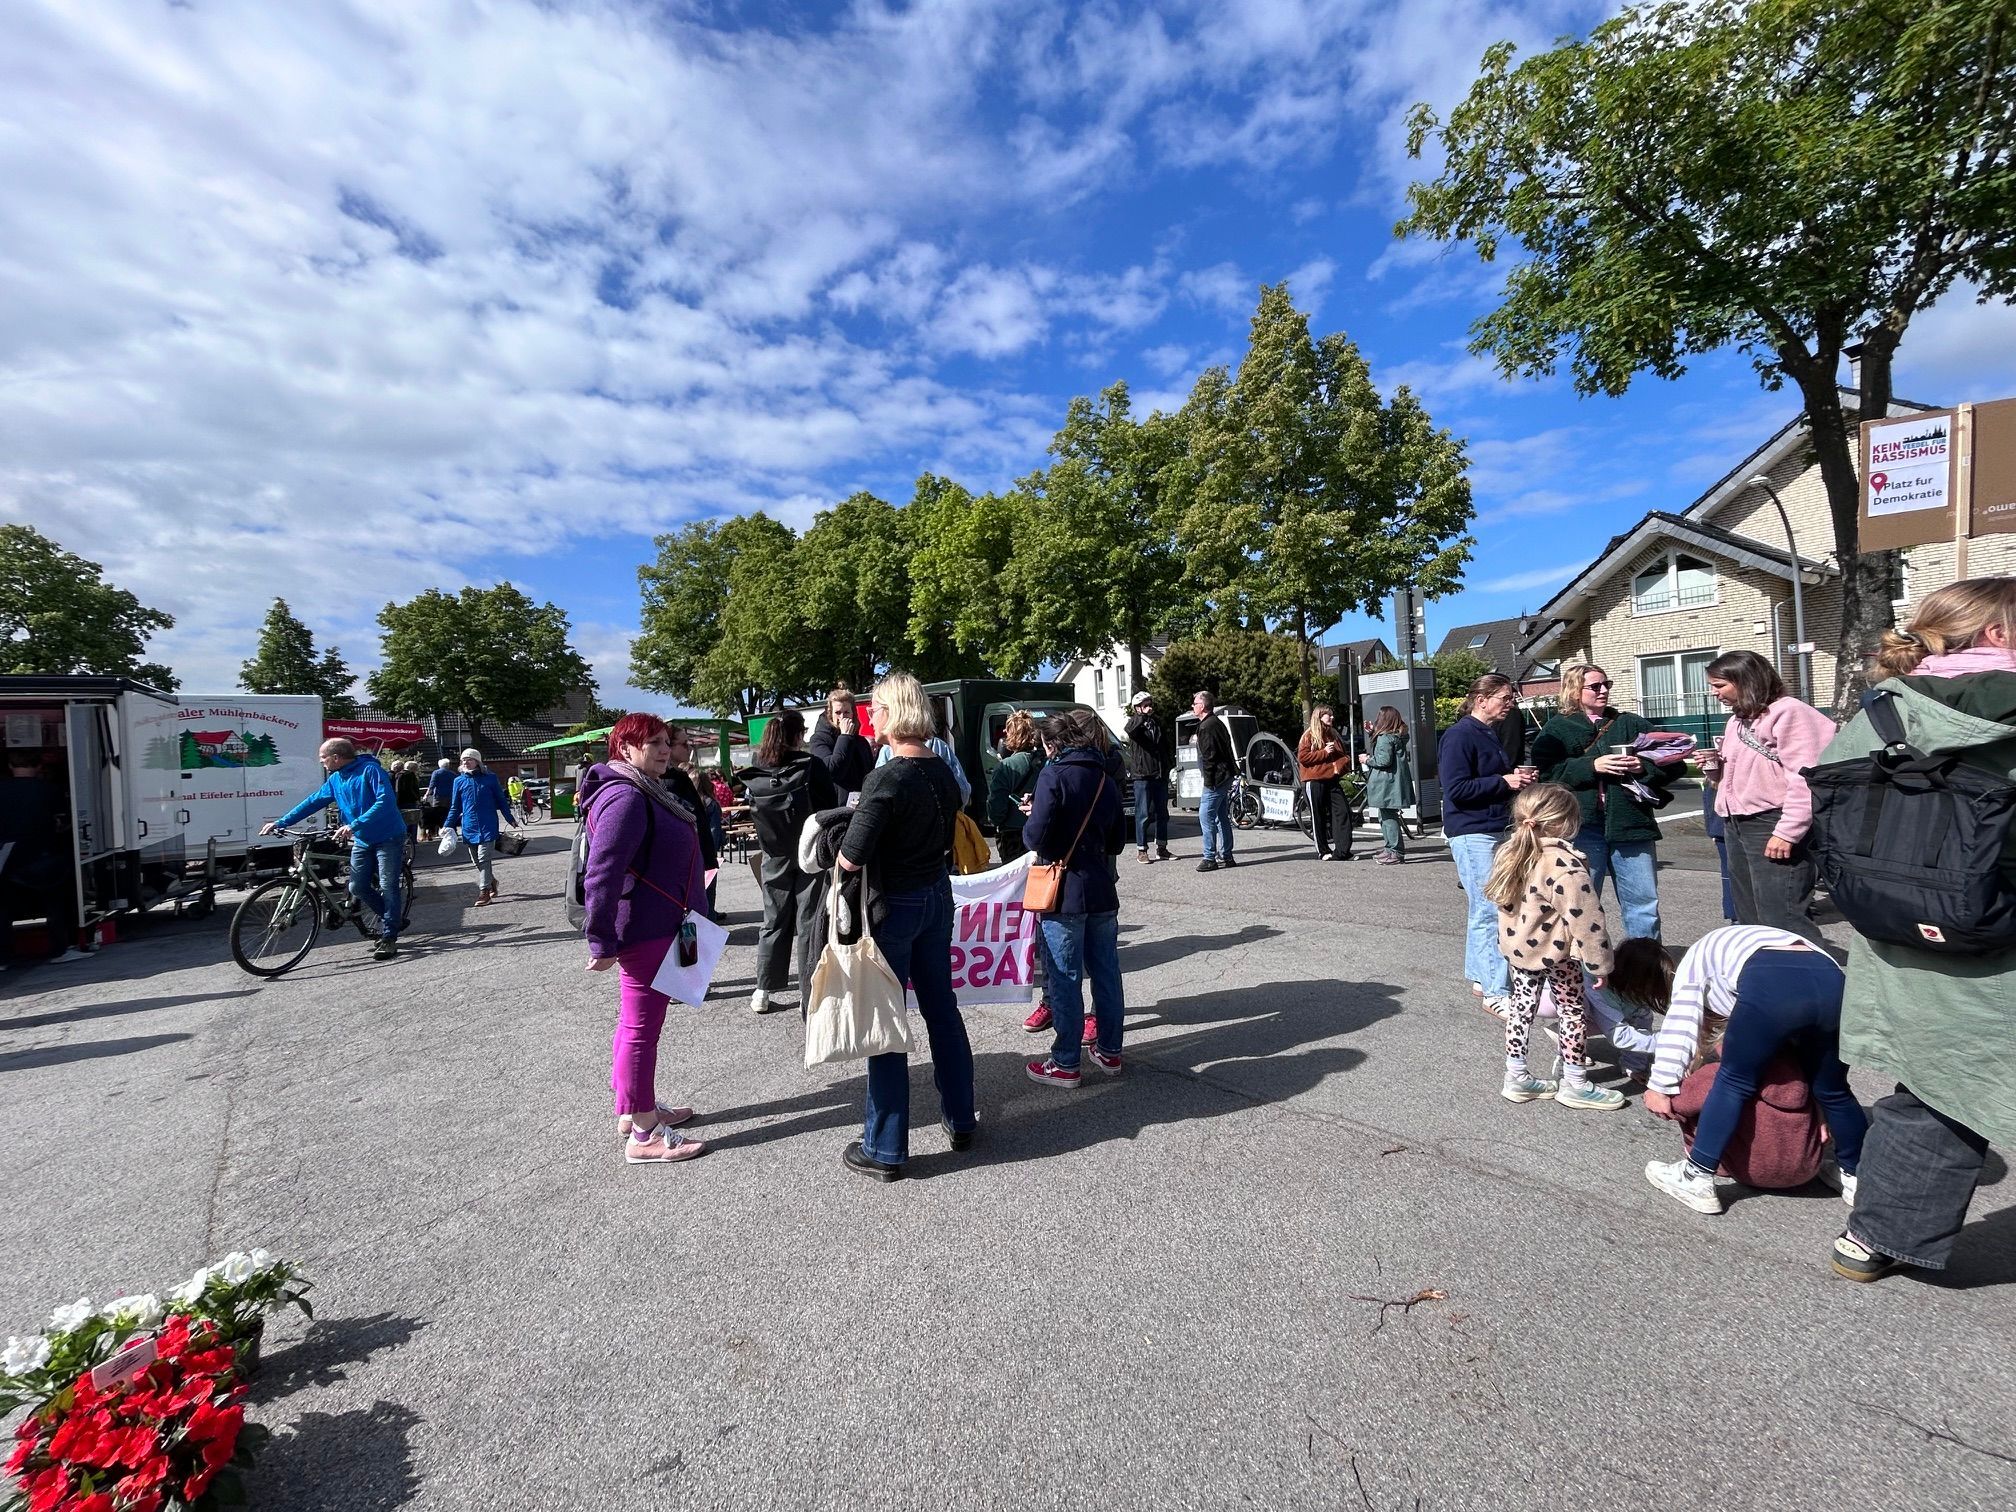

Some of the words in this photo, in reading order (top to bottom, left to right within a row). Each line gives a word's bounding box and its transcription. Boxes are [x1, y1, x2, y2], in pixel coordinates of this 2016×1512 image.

[1872, 441, 1901, 454] KEIN
[1902, 440, 1930, 450] VEEDEL
[1872, 444, 1947, 464] RASSISMUS
[1884, 480, 1912, 491] Platz
[1873, 488, 1943, 506] Demokratie
[208, 708, 300, 730] Mühlenbäckerei
[200, 791, 234, 800] Eifeler
[236, 789, 284, 798] Landbrot
